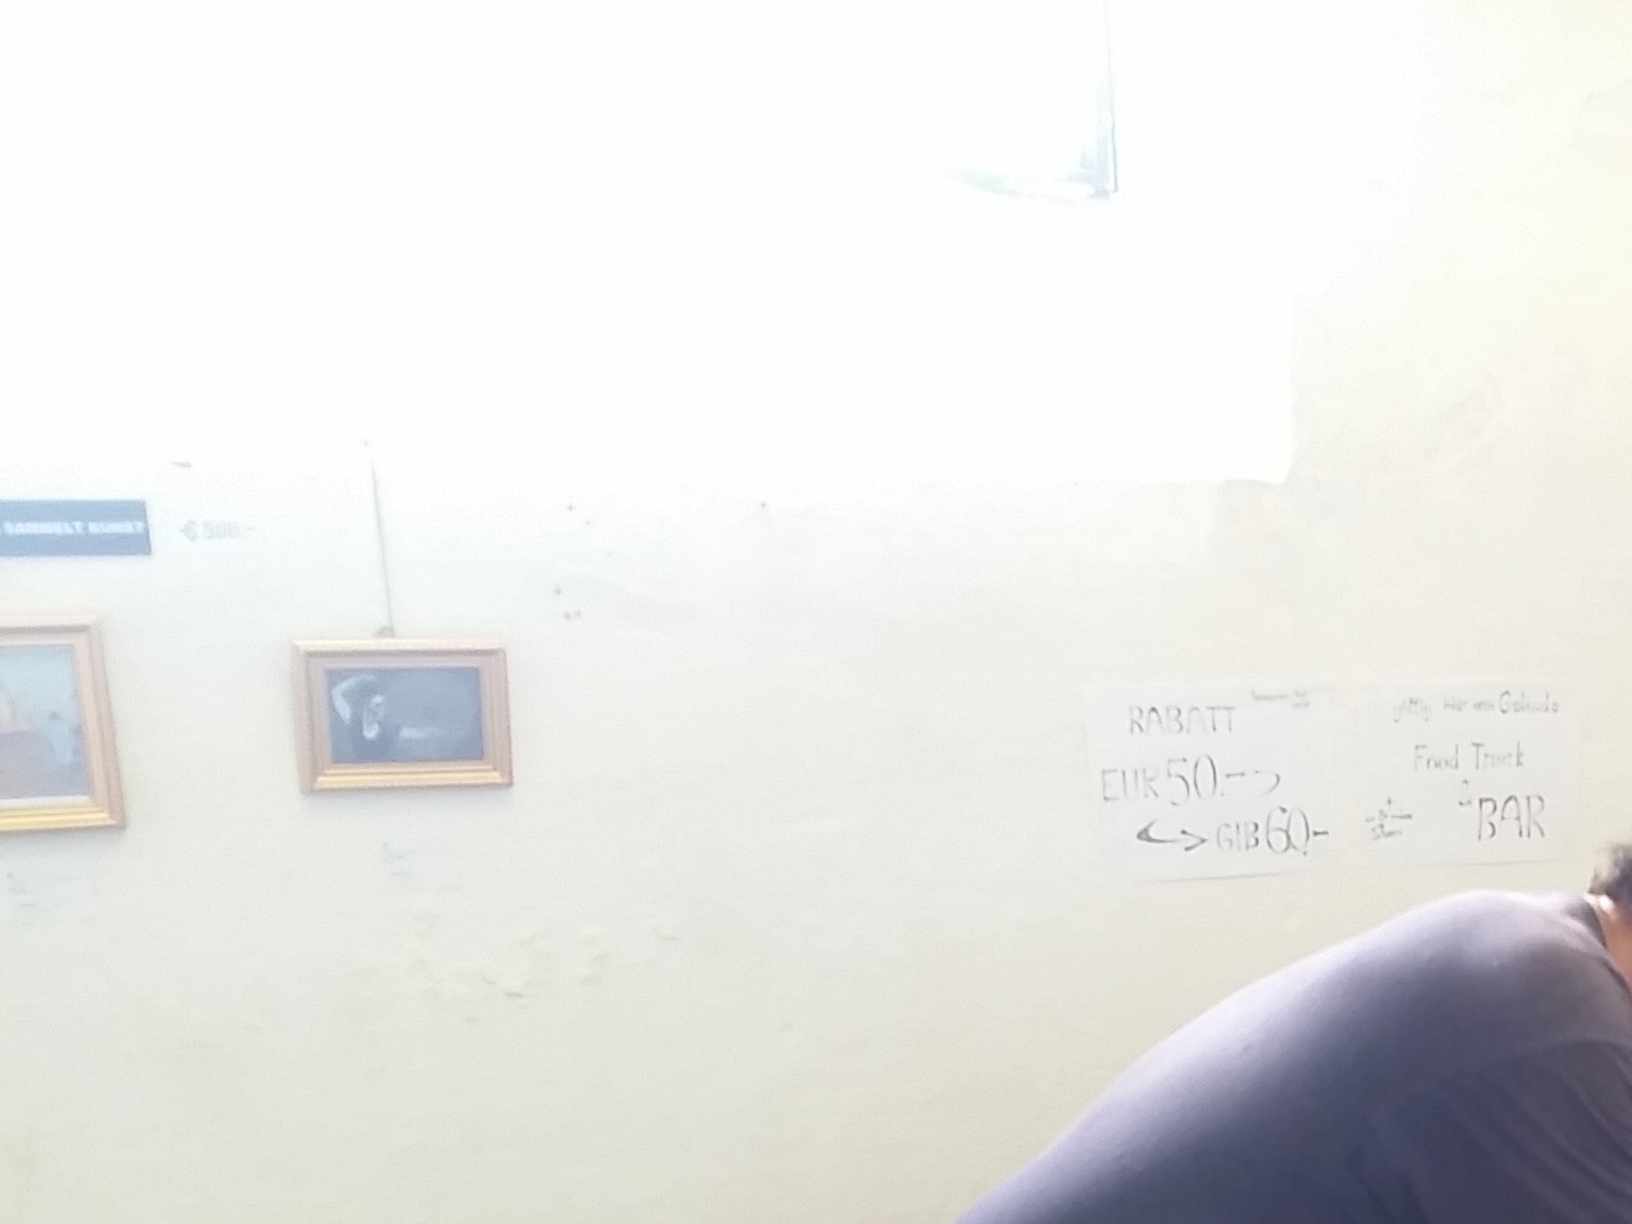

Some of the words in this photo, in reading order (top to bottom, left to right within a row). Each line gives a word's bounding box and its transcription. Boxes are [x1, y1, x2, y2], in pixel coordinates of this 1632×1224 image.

[1127, 704, 1237, 736] RABATT
[1413, 743, 1460, 772] Food
[1476, 793, 1547, 842] BAR
